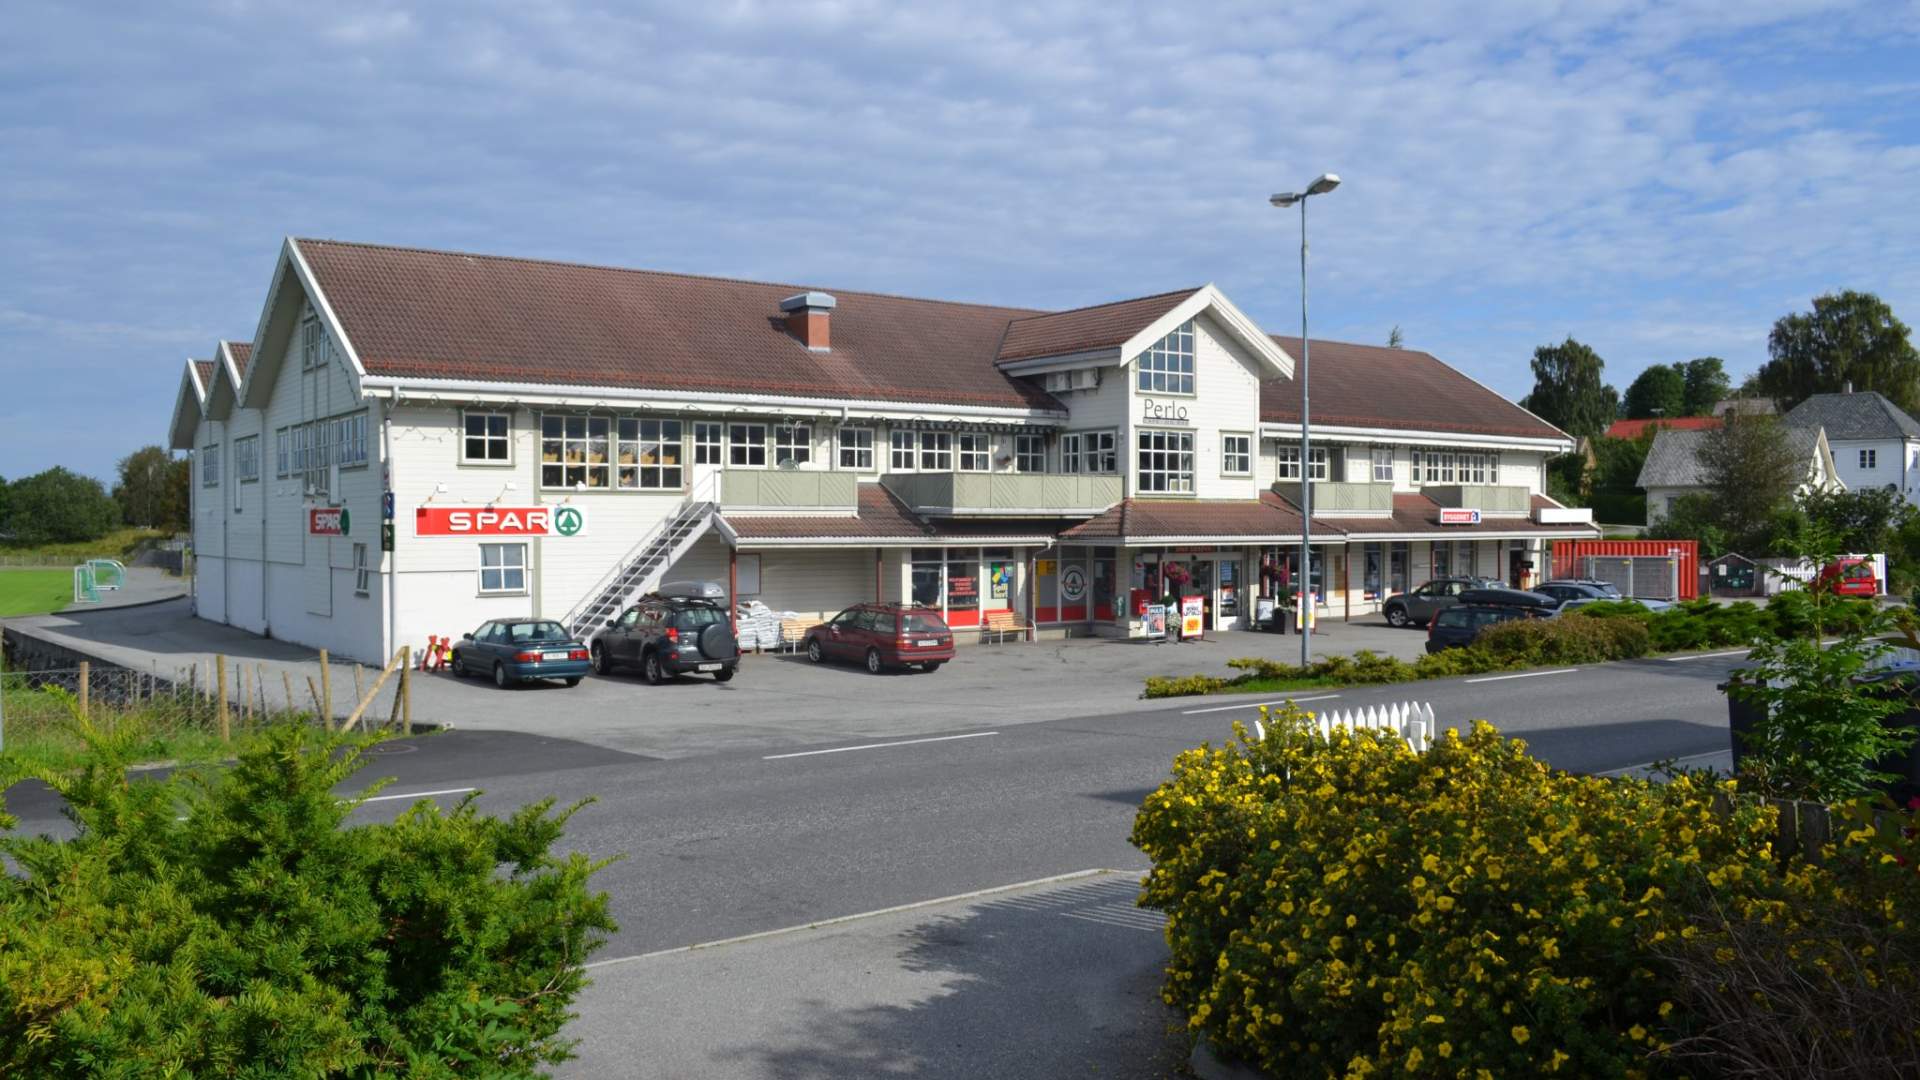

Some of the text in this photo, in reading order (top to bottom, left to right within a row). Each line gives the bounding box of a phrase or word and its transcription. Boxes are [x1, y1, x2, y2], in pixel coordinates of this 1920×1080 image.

[1144, 399, 1188, 420] Perlo
[315, 513, 341, 530] SPAR
[449, 512, 549, 531] SPAR
